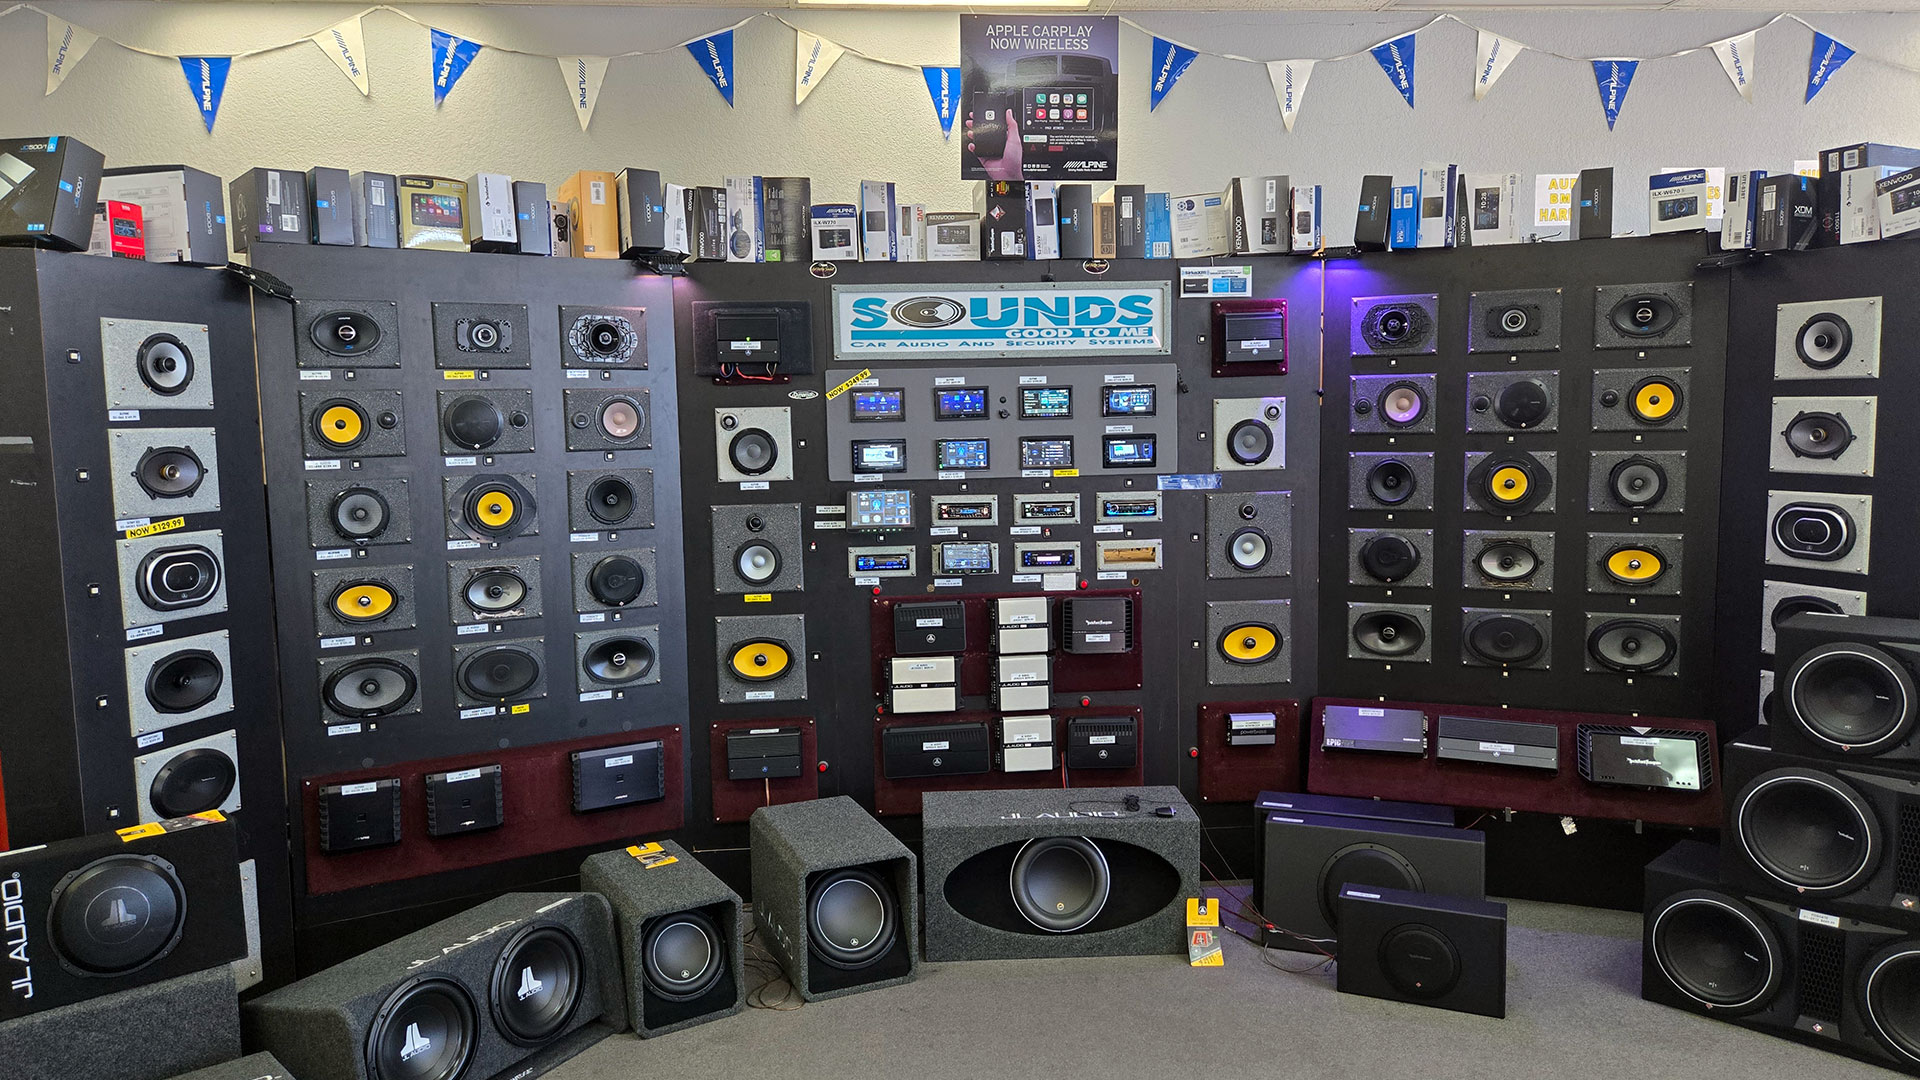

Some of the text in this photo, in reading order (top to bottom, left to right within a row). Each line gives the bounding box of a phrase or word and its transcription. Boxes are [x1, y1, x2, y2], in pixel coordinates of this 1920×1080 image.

[986, 25, 1093, 38] APPLE CARPLAY
[990, 39, 1089, 50] NOW WIRELESS
[1669, 173, 1705, 183] ALPINE
[1877, 173, 1914, 190] KENWOOD
[1794, 205, 1813, 215] XDM
[1235, 216, 1243, 250] KENWOOD
[850, 294, 1154, 328] SOUNDS
[1005, 325, 1153, 339] GOOD TO ME
[850, 339, 1155, 350] CAR AUDIO AND SECURITY SYSTEMS
[828, 385, 844, 399] NOW
[129, 528, 150, 538] NOW
[152, 519, 182, 532] $129.99
[1036, 811, 1119, 820] AUDIO
[1, 878, 34, 999] JL AUDIO
[407, 919, 516, 970] JL AUDIO
[525, 986, 544, 997] AUDIO
[410, 1044, 432, 1058] AUDIO
